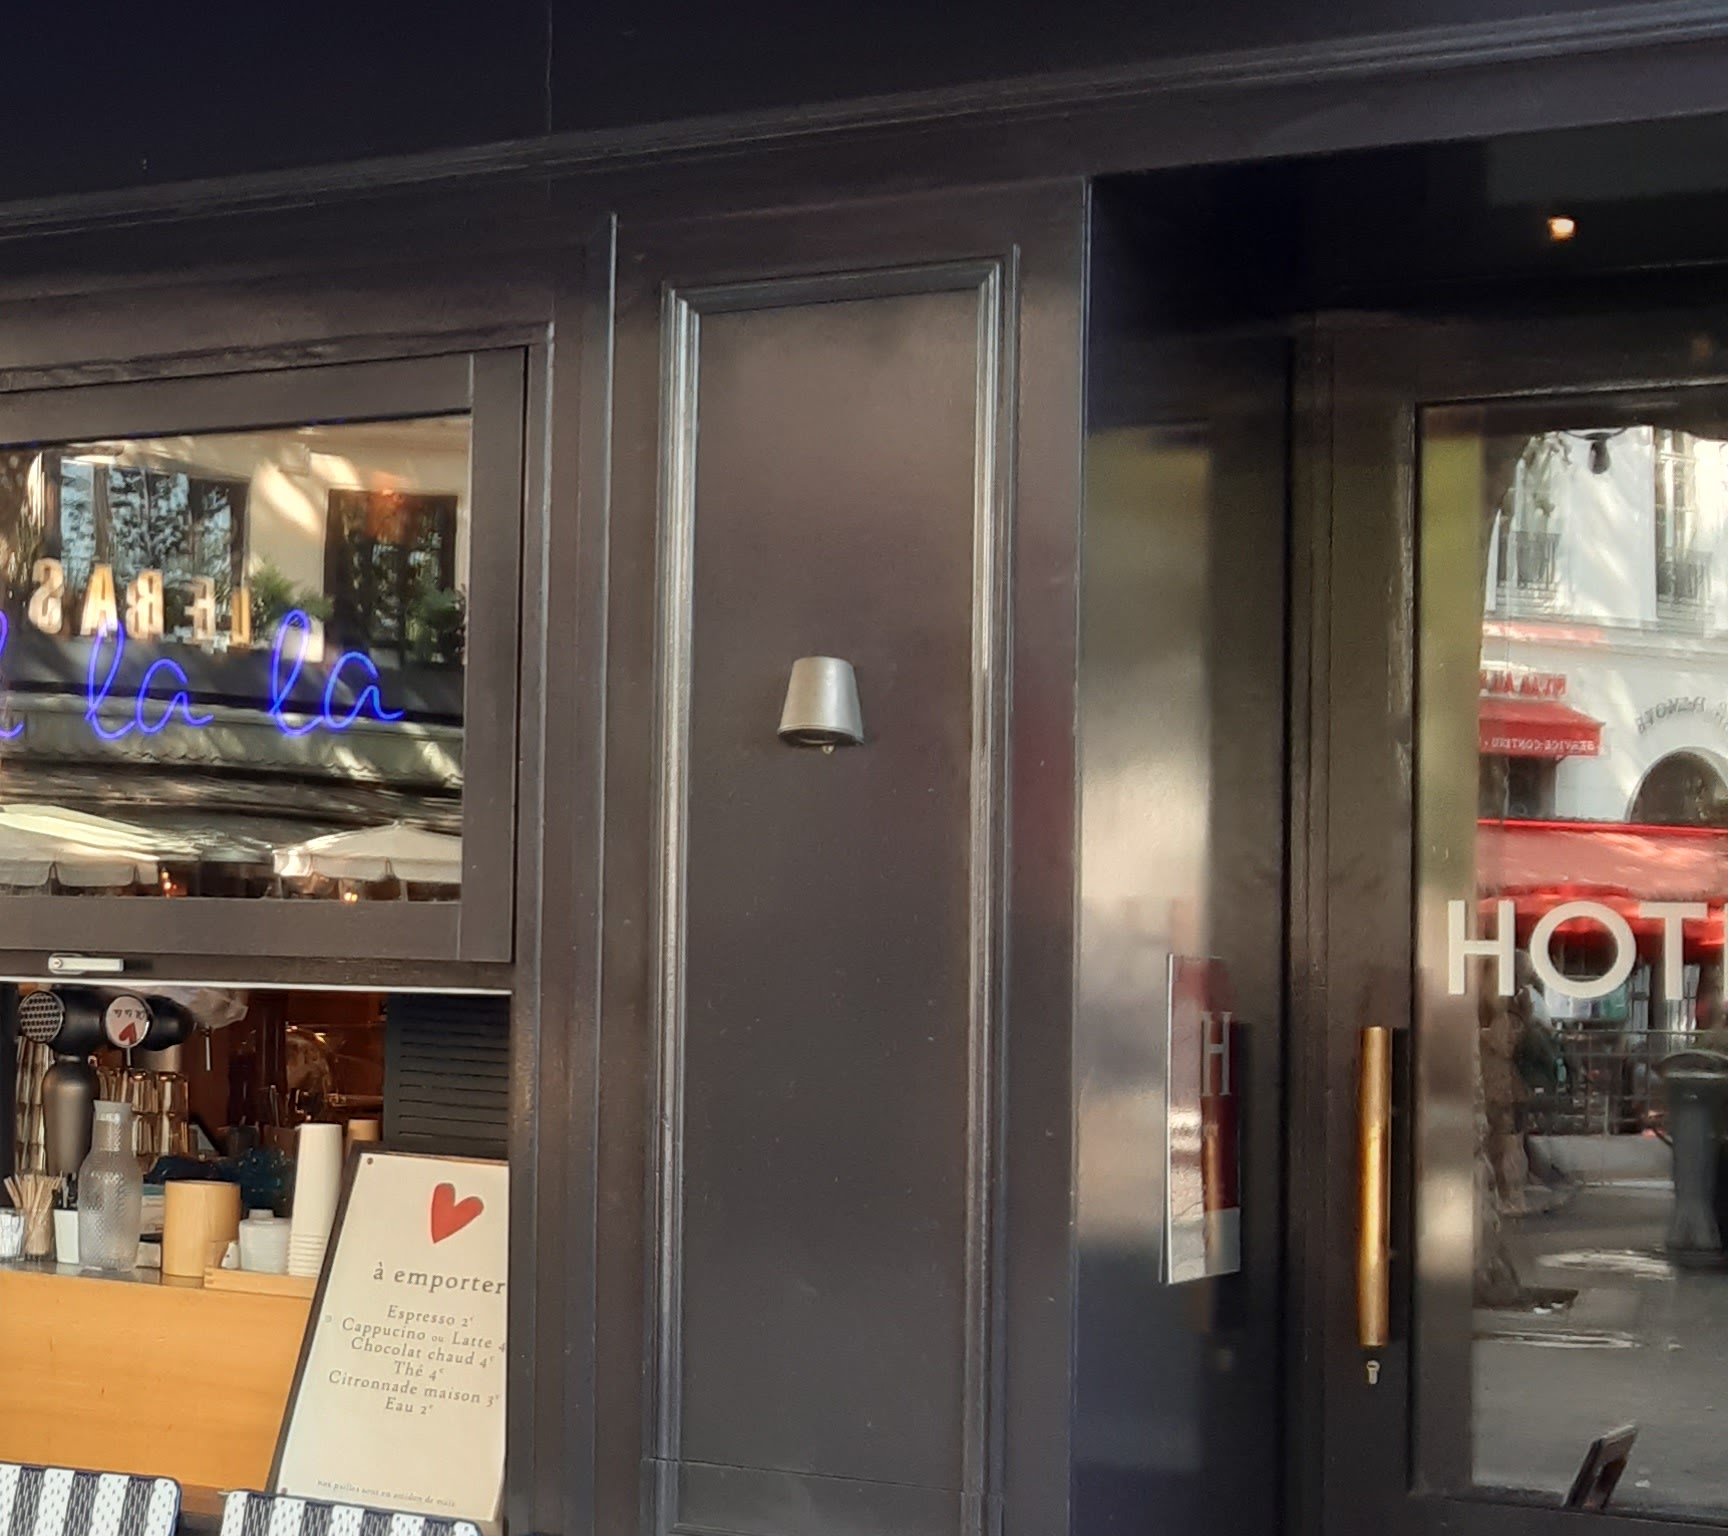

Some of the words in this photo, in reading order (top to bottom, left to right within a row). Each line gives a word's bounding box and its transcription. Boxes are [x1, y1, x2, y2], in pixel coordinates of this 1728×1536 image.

[84, 616, 213, 740] la
[269, 608, 405, 737] la
[1448, 899, 1728, 1001] HOT
[373, 1261, 384, 1281] à
[393, 1268, 507, 1295] emporter
[387, 1304, 456, 1327] Espresso
[342, 1317, 426, 1341] Cappucino
[452, 1331, 493, 1350] Latte
[351, 1336, 422, 1360] Chocolat
[427, 1347, 475, 1365] chaud
[394, 1360, 424, 1377] Thé
[328, 1369, 419, 1395] Citronnade
[424, 1386, 481, 1404] maison
[385, 1396, 414, 1413] Eau
